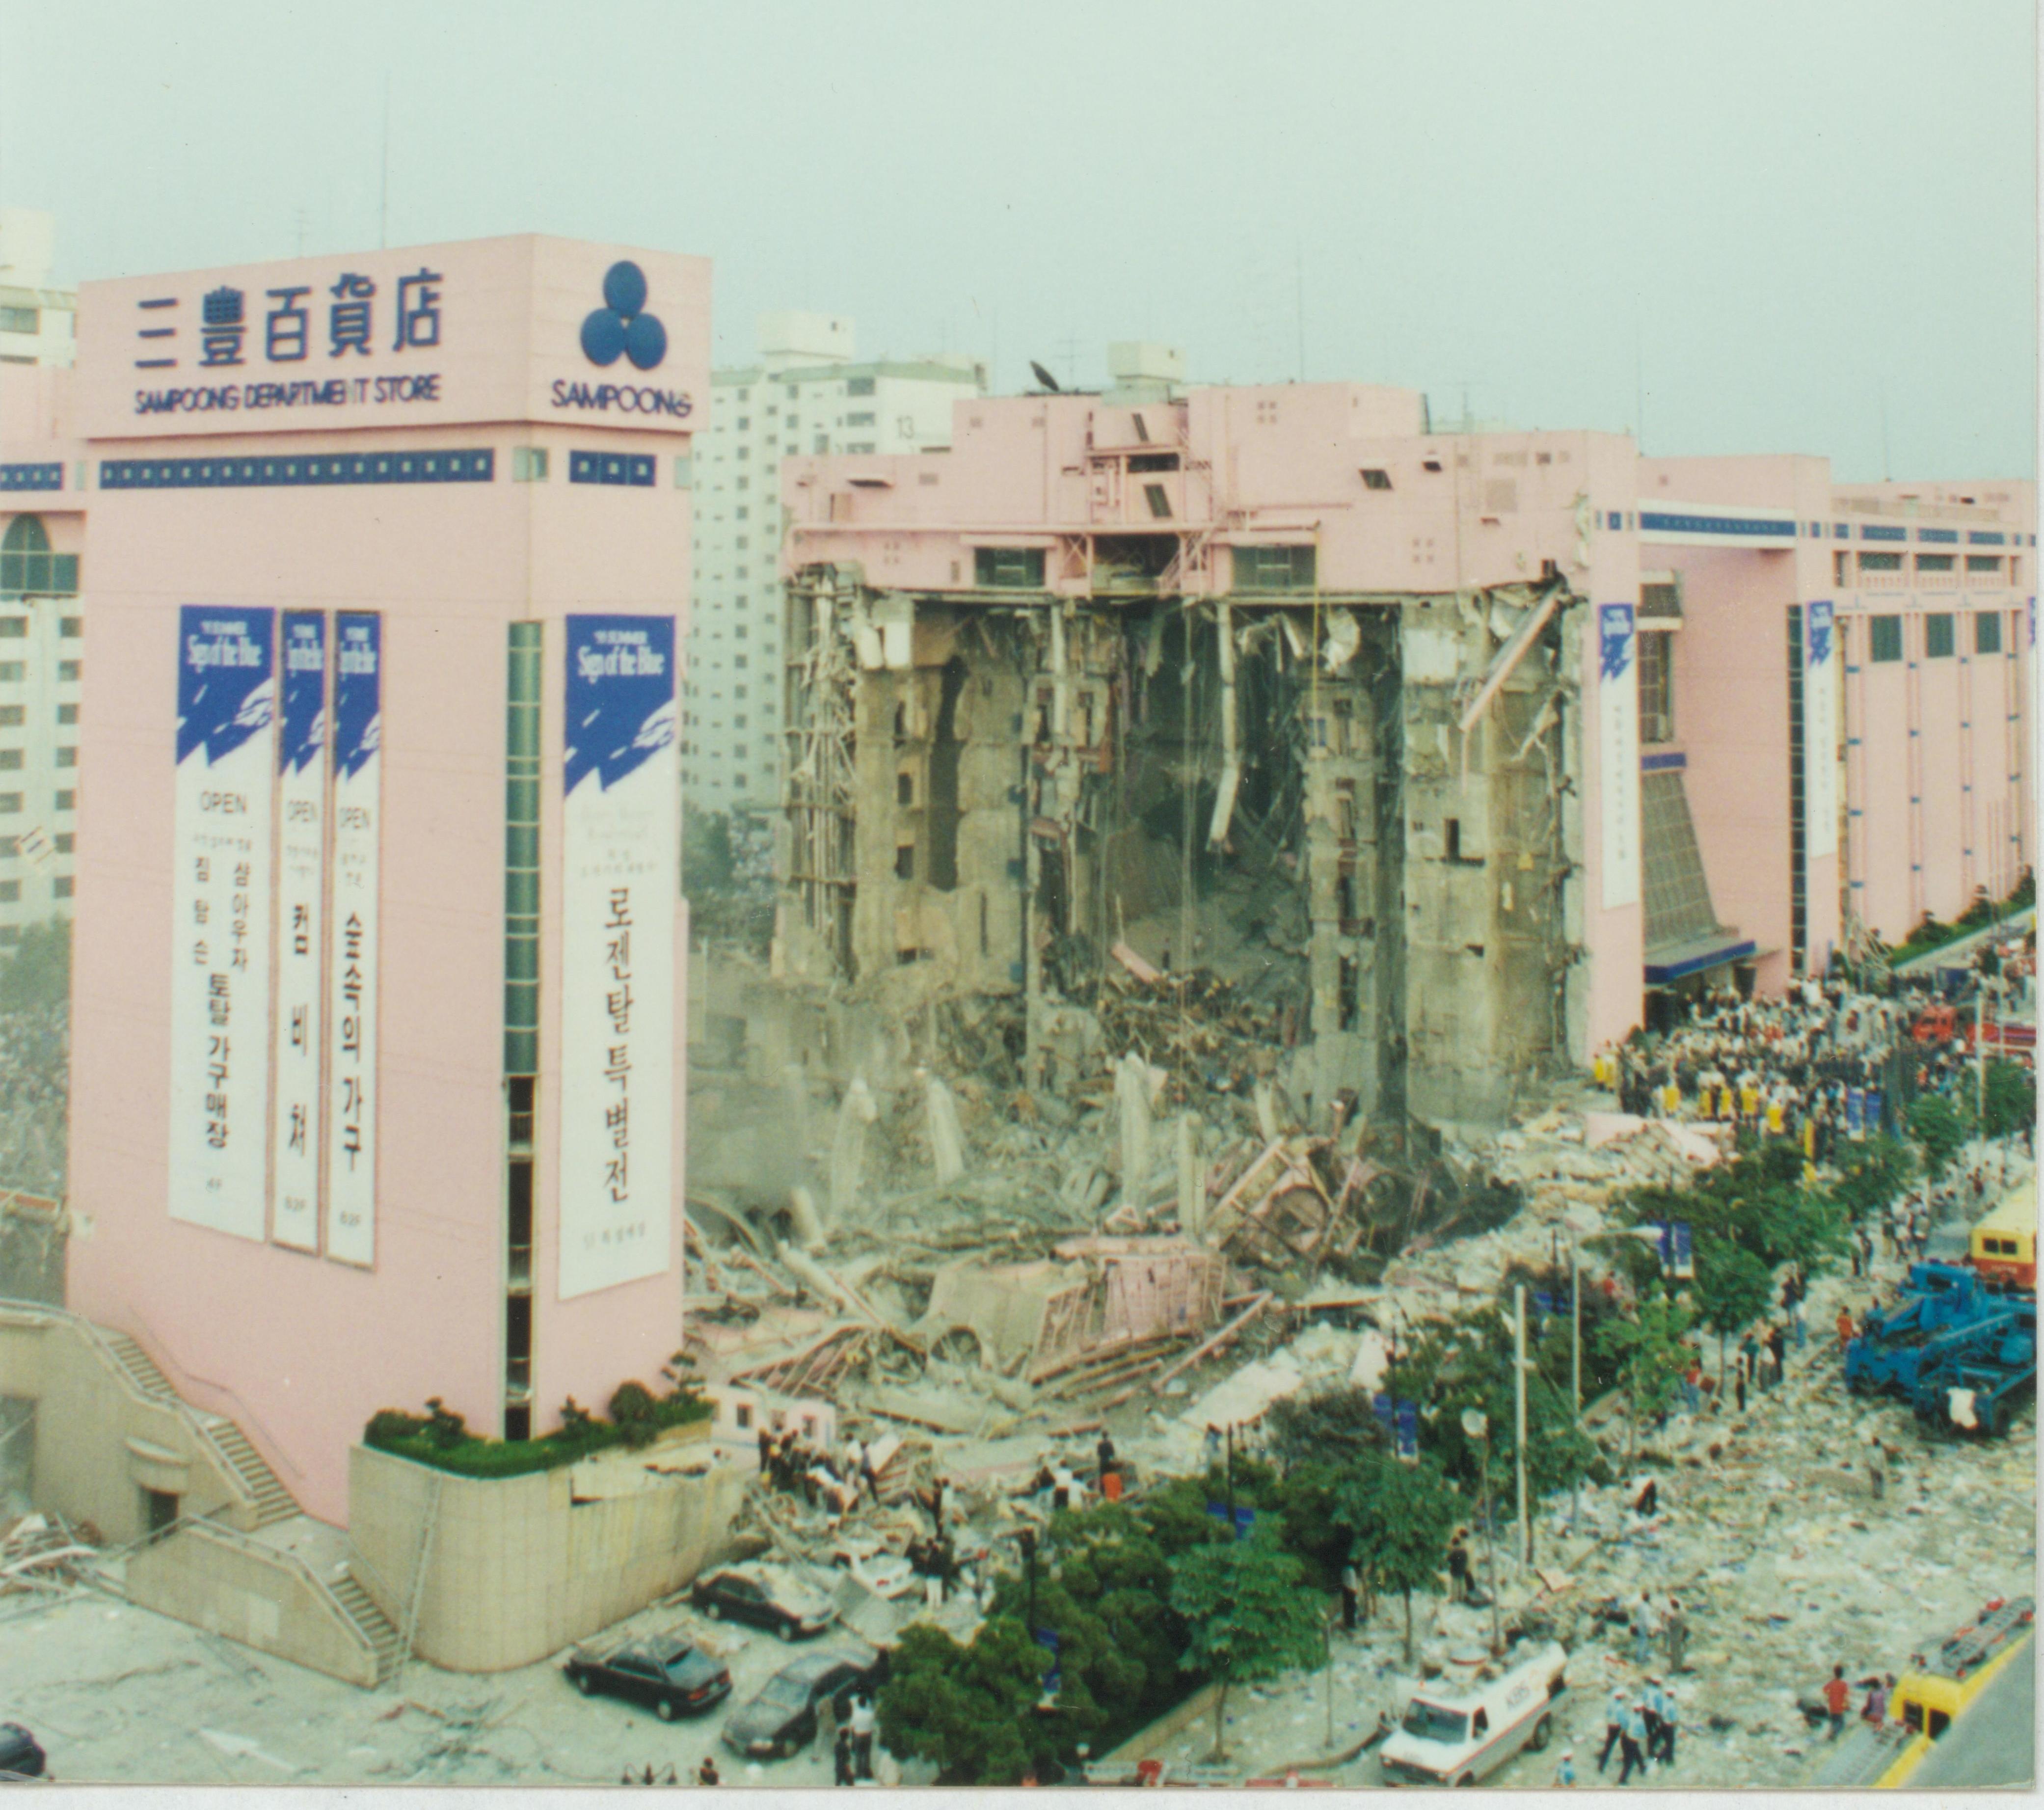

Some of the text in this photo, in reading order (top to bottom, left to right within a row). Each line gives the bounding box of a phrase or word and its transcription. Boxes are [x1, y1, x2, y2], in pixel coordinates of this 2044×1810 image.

[134, 373, 441, 414] SAMPOONG DEPARTMET STORE
[550, 378, 693, 419] SAMPOONG
[896, 415, 914, 440] 13
[201, 790, 248, 814] OPEN
[288, 800, 319, 823] OPEN
[339, 807, 370, 829] OPEN
[604, 887, 634, 1033] 로젠탈
[603, 1044, 632, 1204] 특별전
